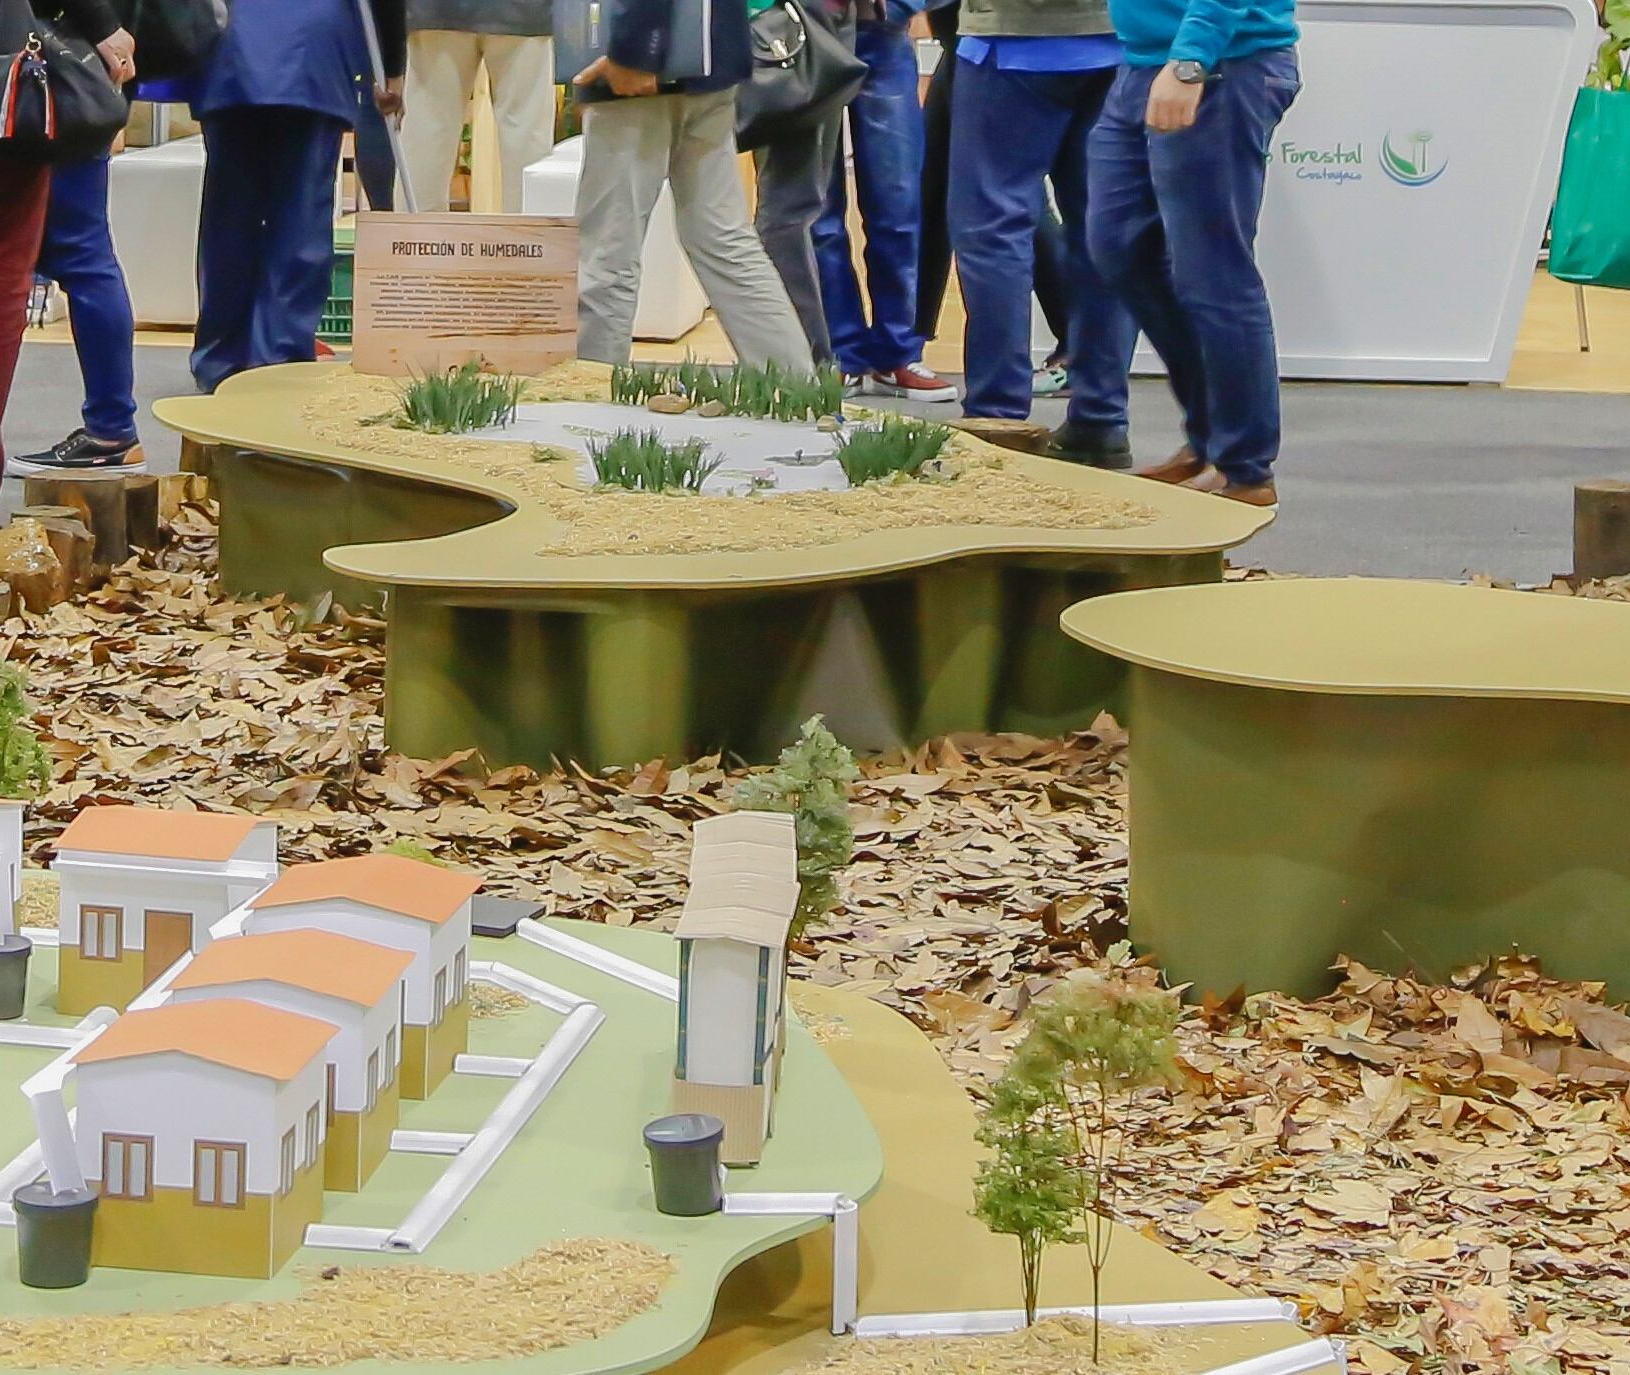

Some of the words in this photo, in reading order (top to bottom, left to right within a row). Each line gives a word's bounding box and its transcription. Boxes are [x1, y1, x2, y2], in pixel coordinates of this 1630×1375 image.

[1281, 143, 1362, 163] Forestal
[392, 240, 455, 257] PROTECCIÓN
[461, 243, 474, 257] DE
[480, 243, 543, 258] HUMEDALES
